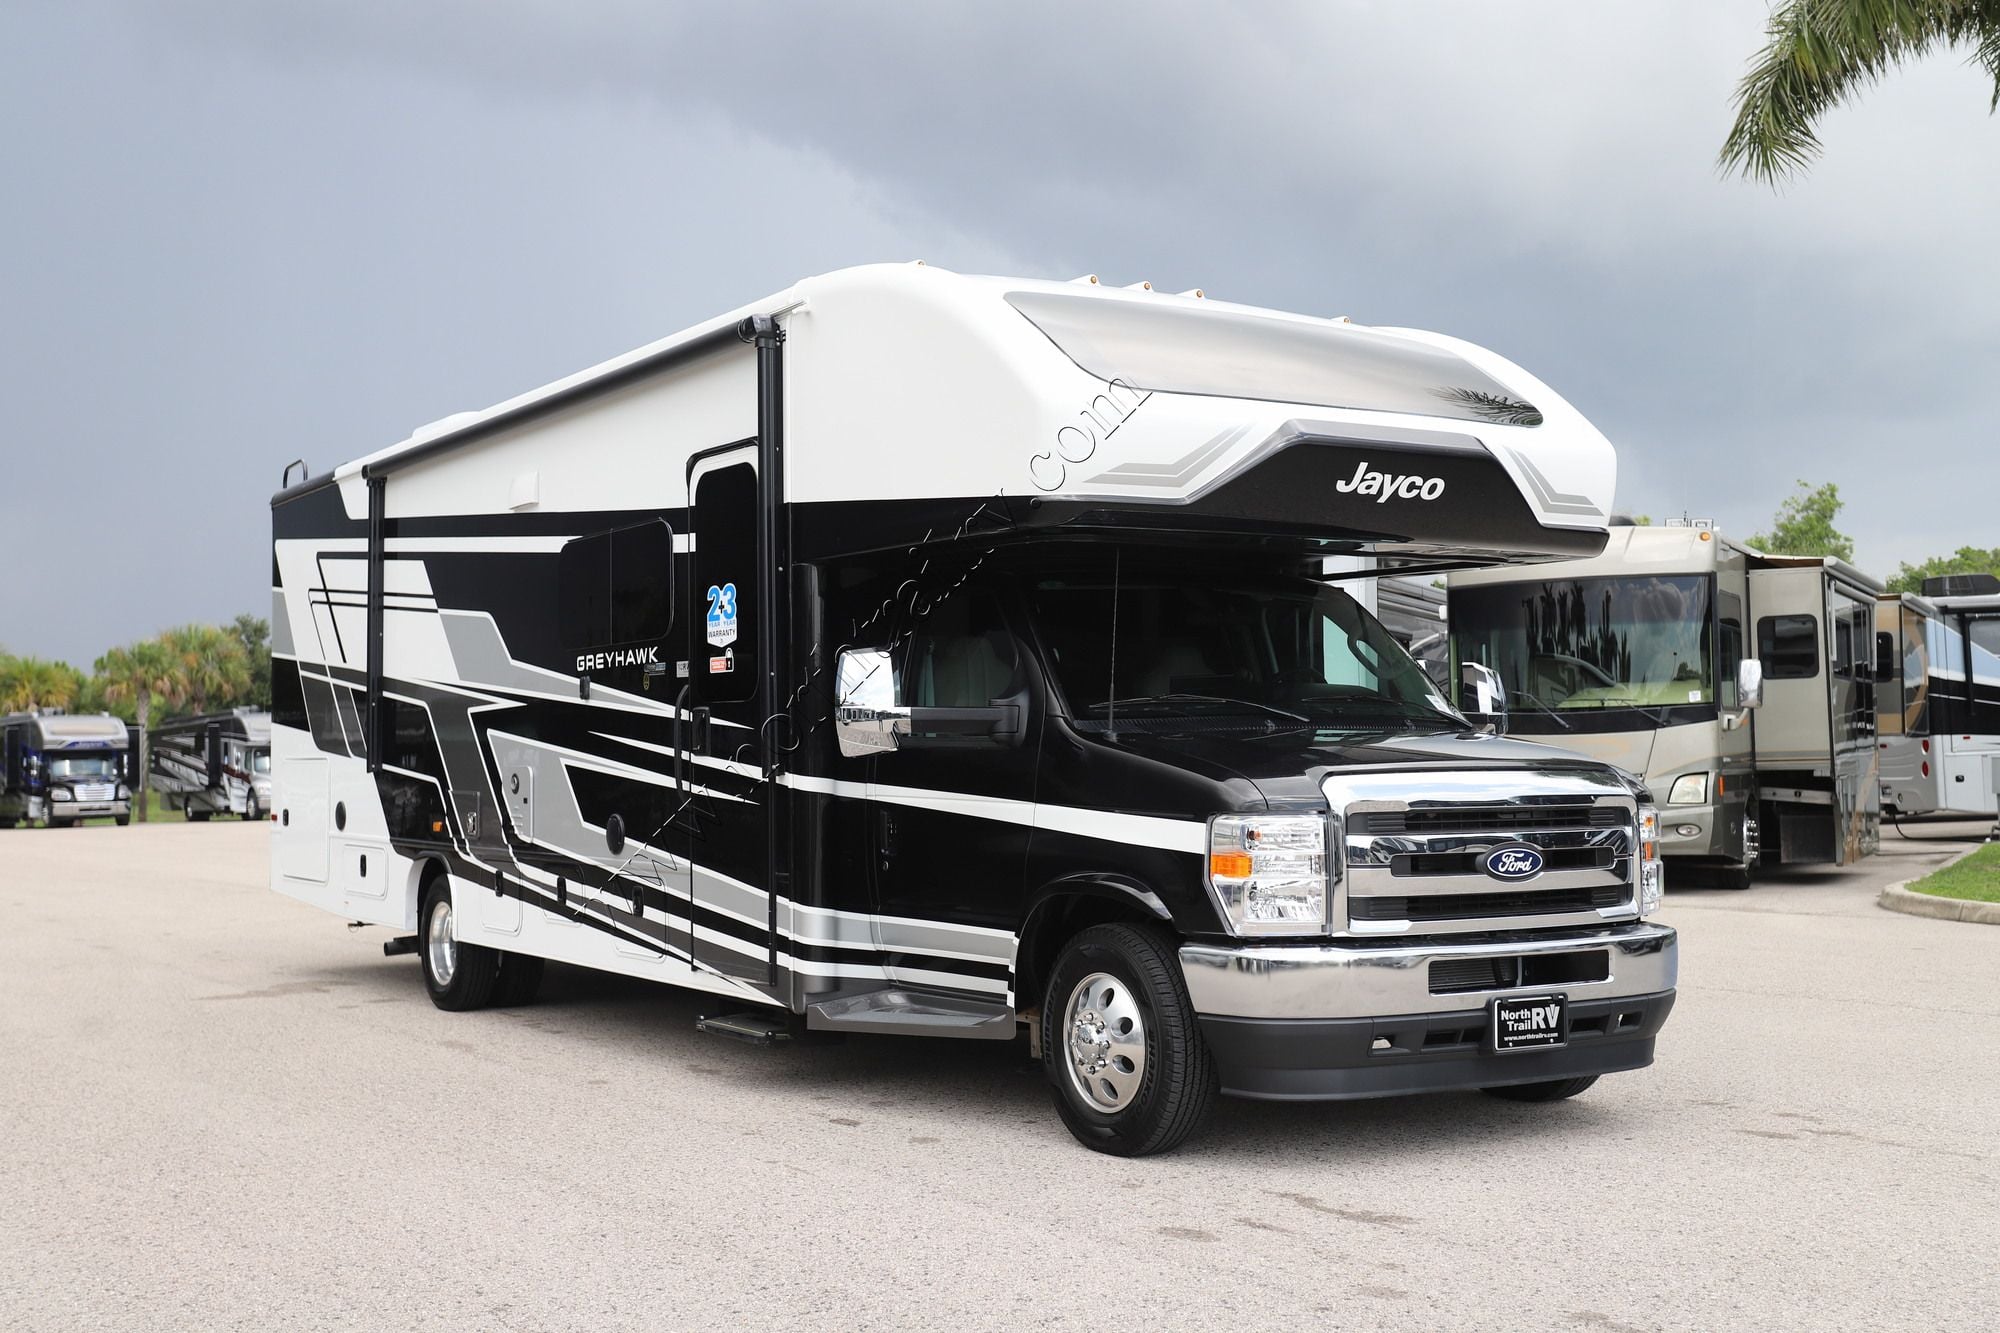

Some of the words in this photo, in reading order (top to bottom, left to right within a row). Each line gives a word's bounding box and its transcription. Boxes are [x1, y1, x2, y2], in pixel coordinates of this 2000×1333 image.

[1336, 462, 1445, 503] Jayco
[708, 628, 736, 638] WARRANTY
[576, 646, 659, 672] GREYHAWK
[1499, 852, 1533, 872] Ford
[1500, 1009, 1531, 1021] North
[1531, 1004, 1560, 1029] RV
[1506, 1020, 1531, 1031] Trail
